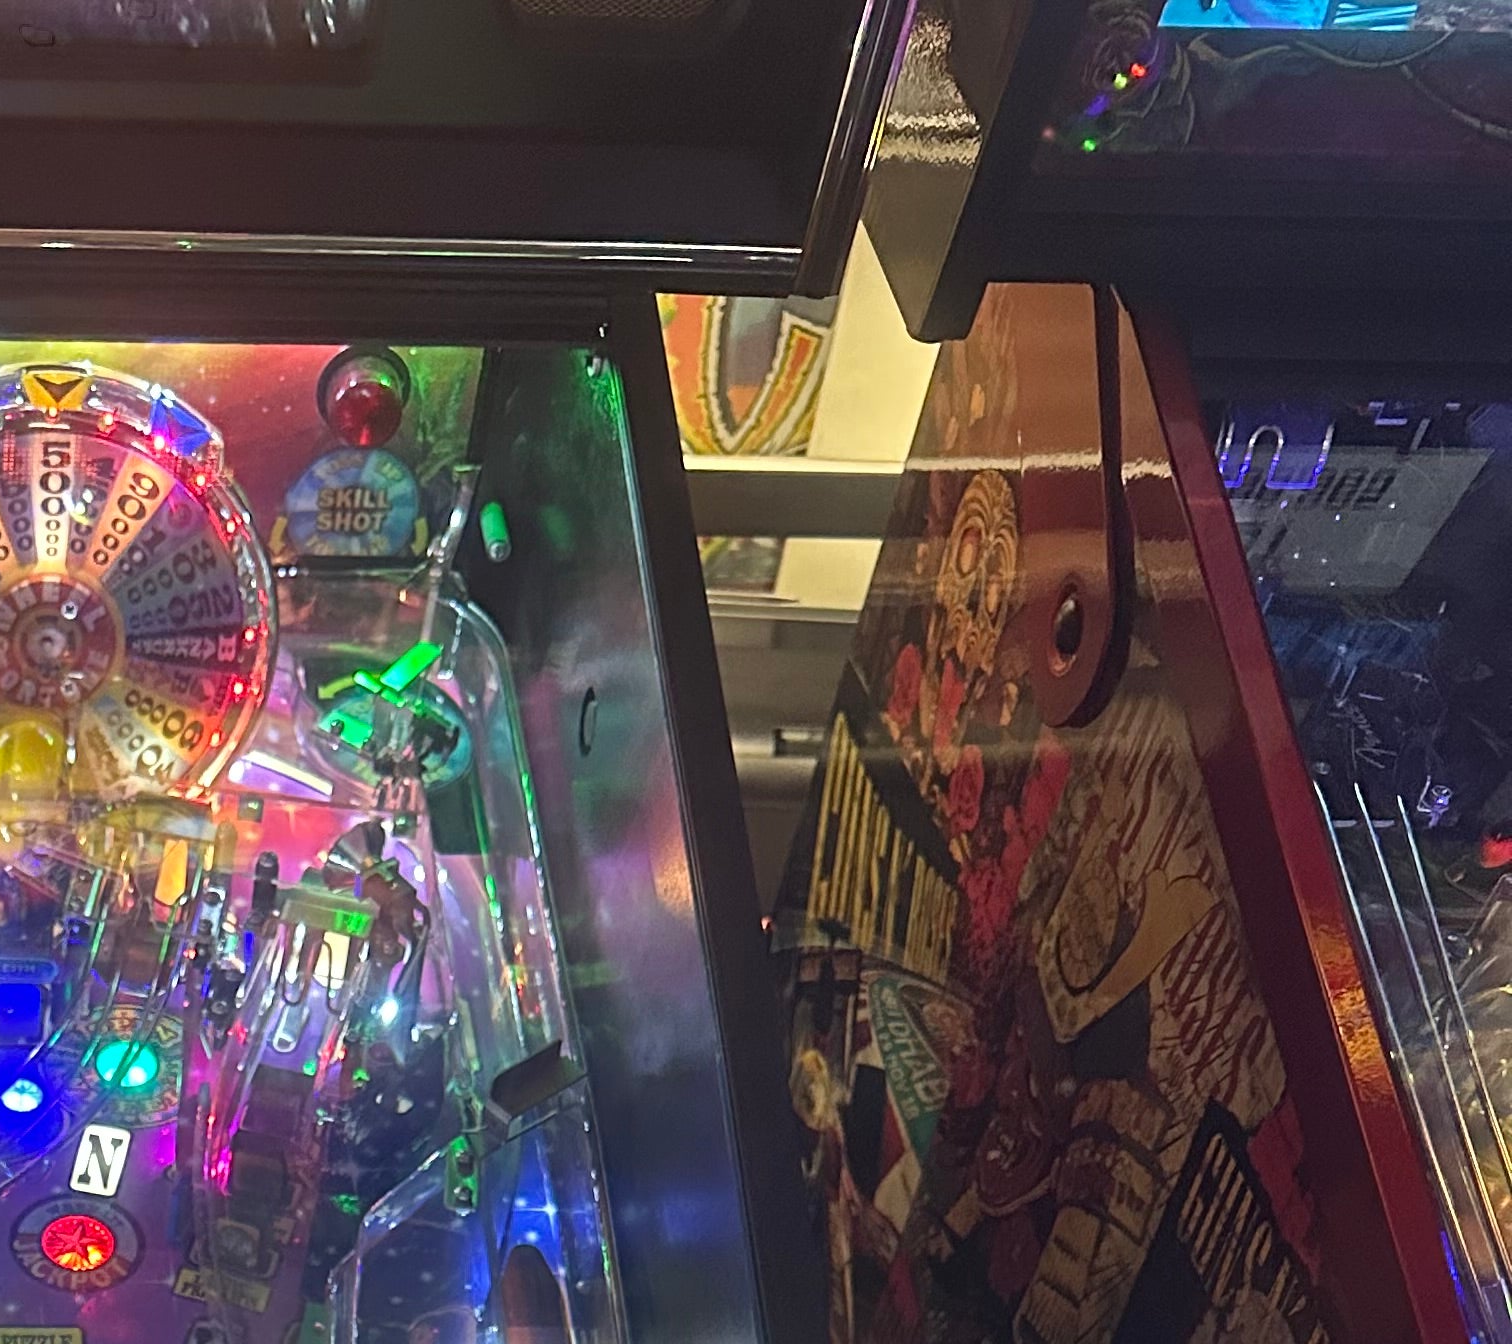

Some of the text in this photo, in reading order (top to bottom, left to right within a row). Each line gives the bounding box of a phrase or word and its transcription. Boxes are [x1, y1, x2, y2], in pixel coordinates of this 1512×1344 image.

[317, 487, 390, 509] SKILL
[316, 509, 387, 533] SHOT
[78, 1134, 124, 1190] N
